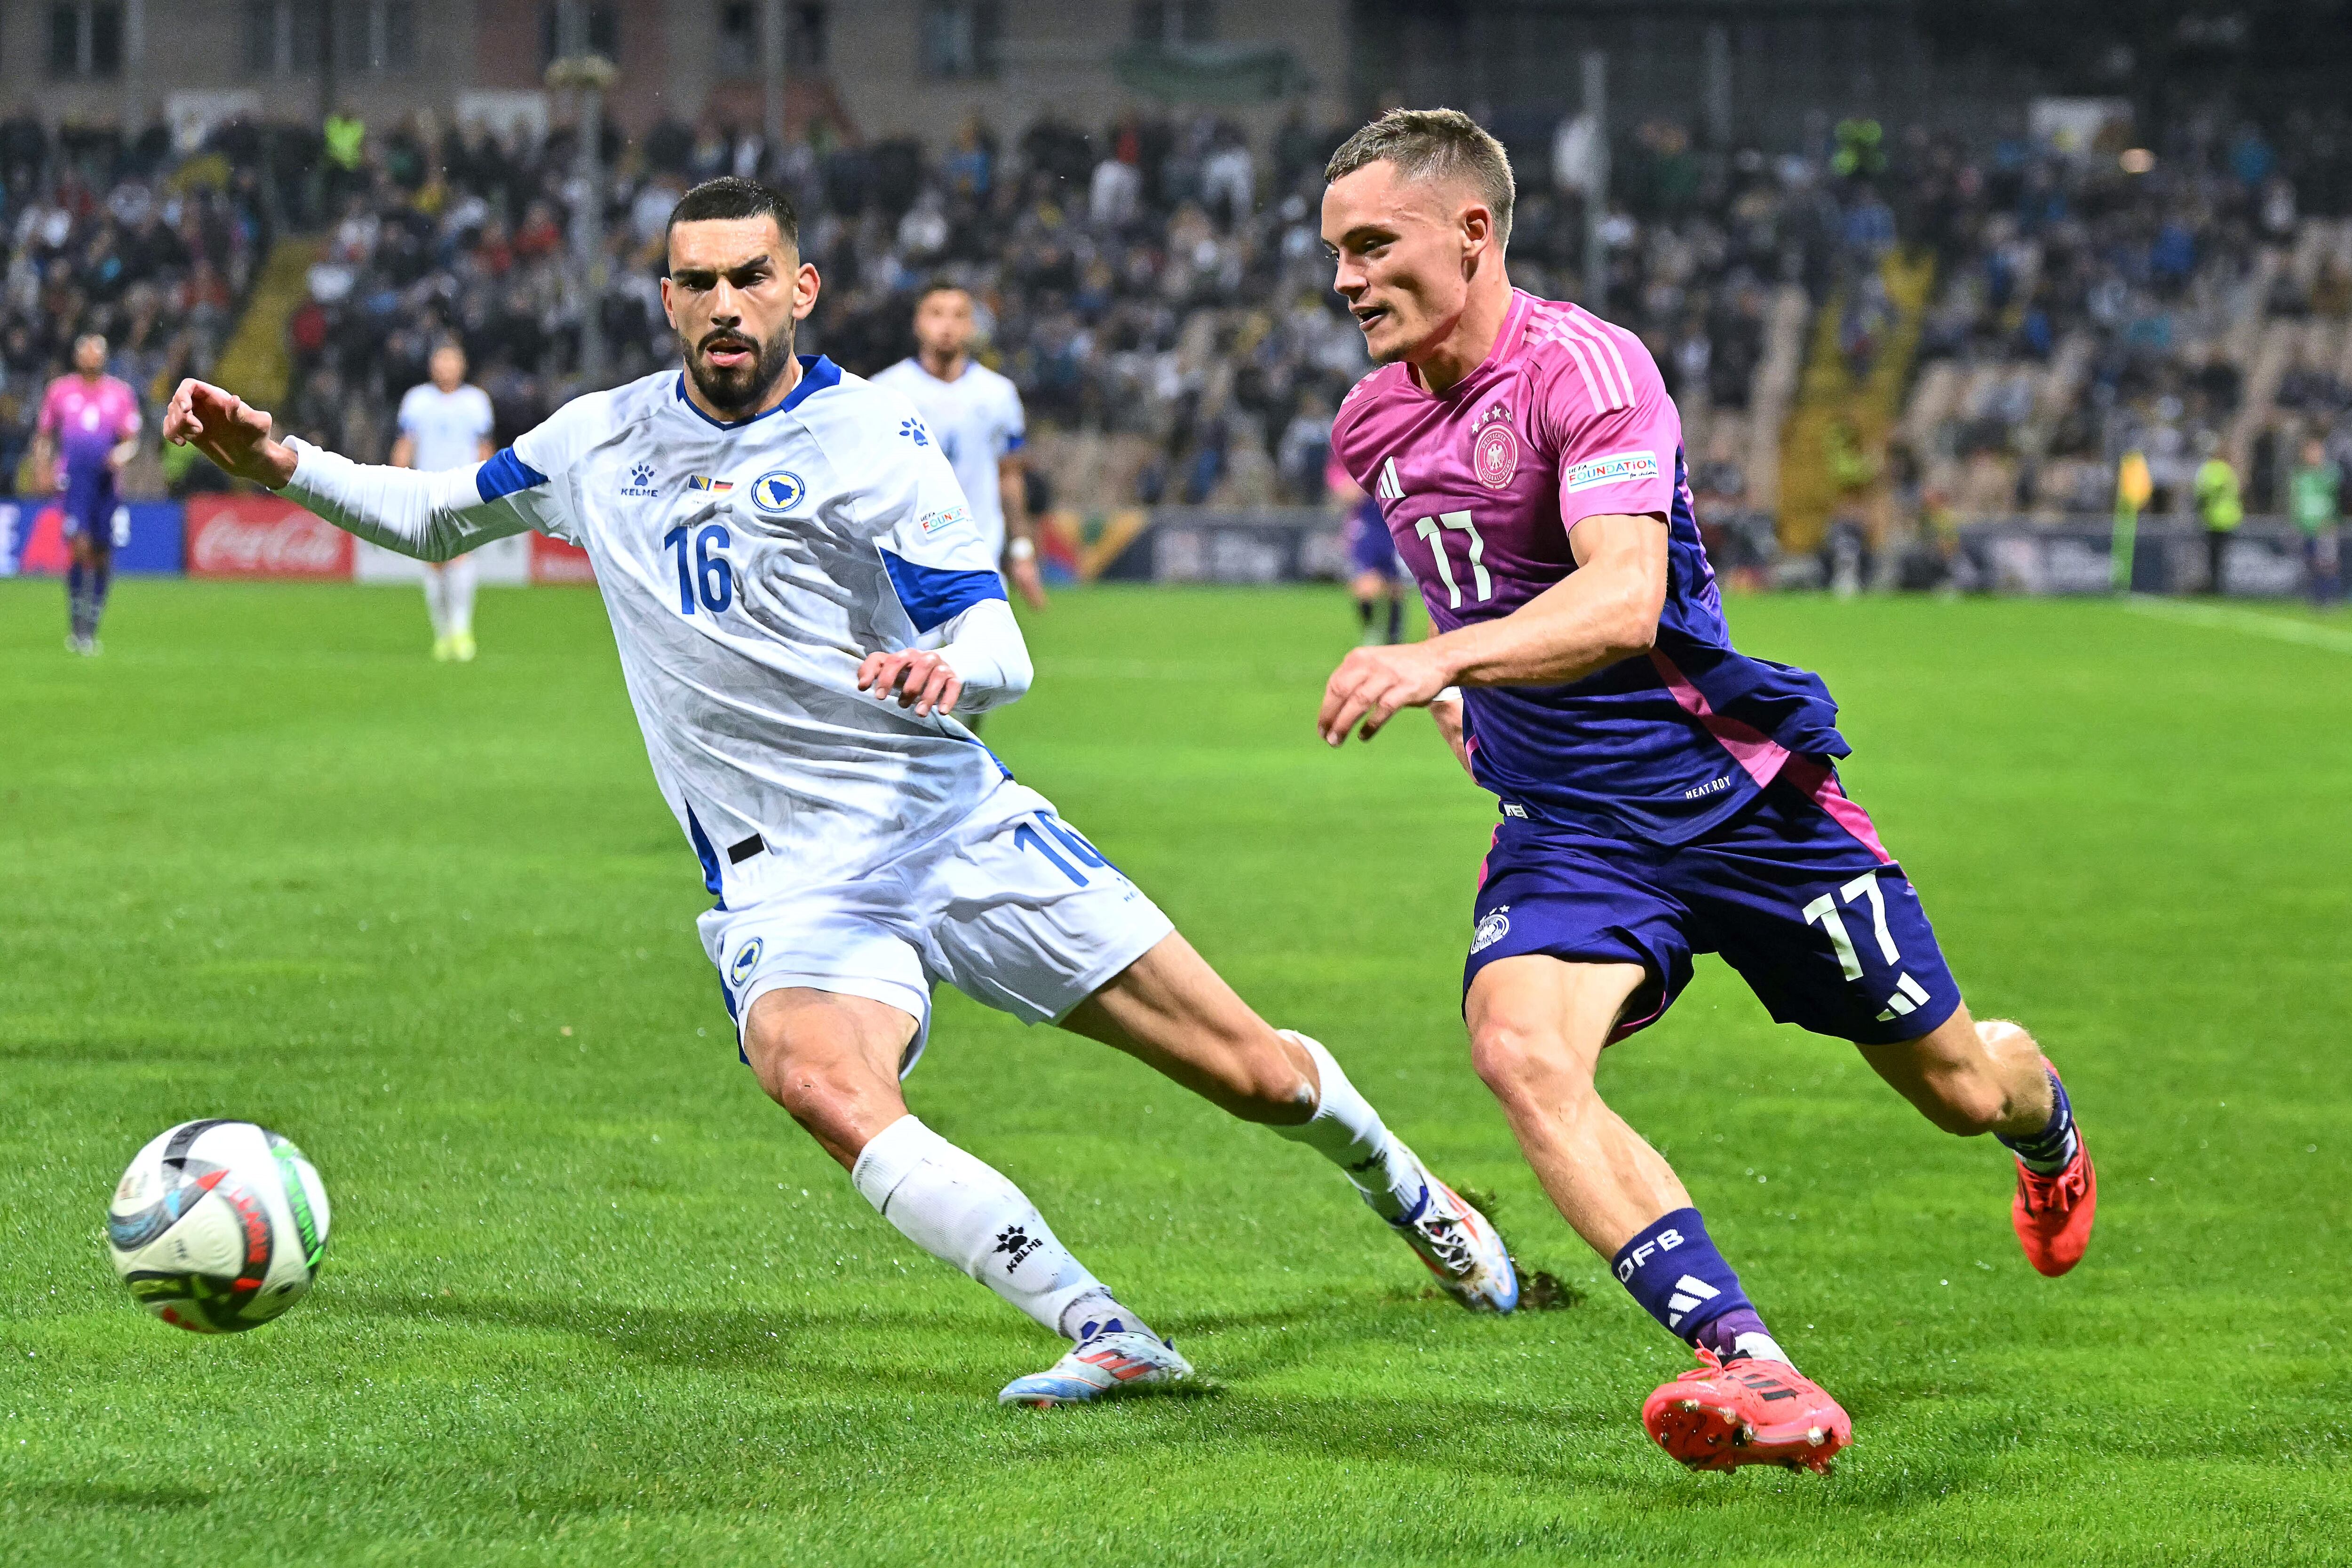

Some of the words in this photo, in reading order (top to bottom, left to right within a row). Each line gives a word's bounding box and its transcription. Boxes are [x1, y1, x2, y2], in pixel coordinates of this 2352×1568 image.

[1482, 433, 1506, 449] DEUTSCHER
[1569, 464, 1587, 474] UEFA
[1569, 460, 1656, 483] FOUNDATION
[620, 488, 658, 497] KELME
[920, 512, 935, 521] UEFA
[664, 525, 731, 615] 16
[1415, 510, 1492, 609] 17
[1803, 869, 1900, 981] 17
[1006, 1238, 1043, 1274] KELME
[1618, 1228, 1685, 1283] DFB
